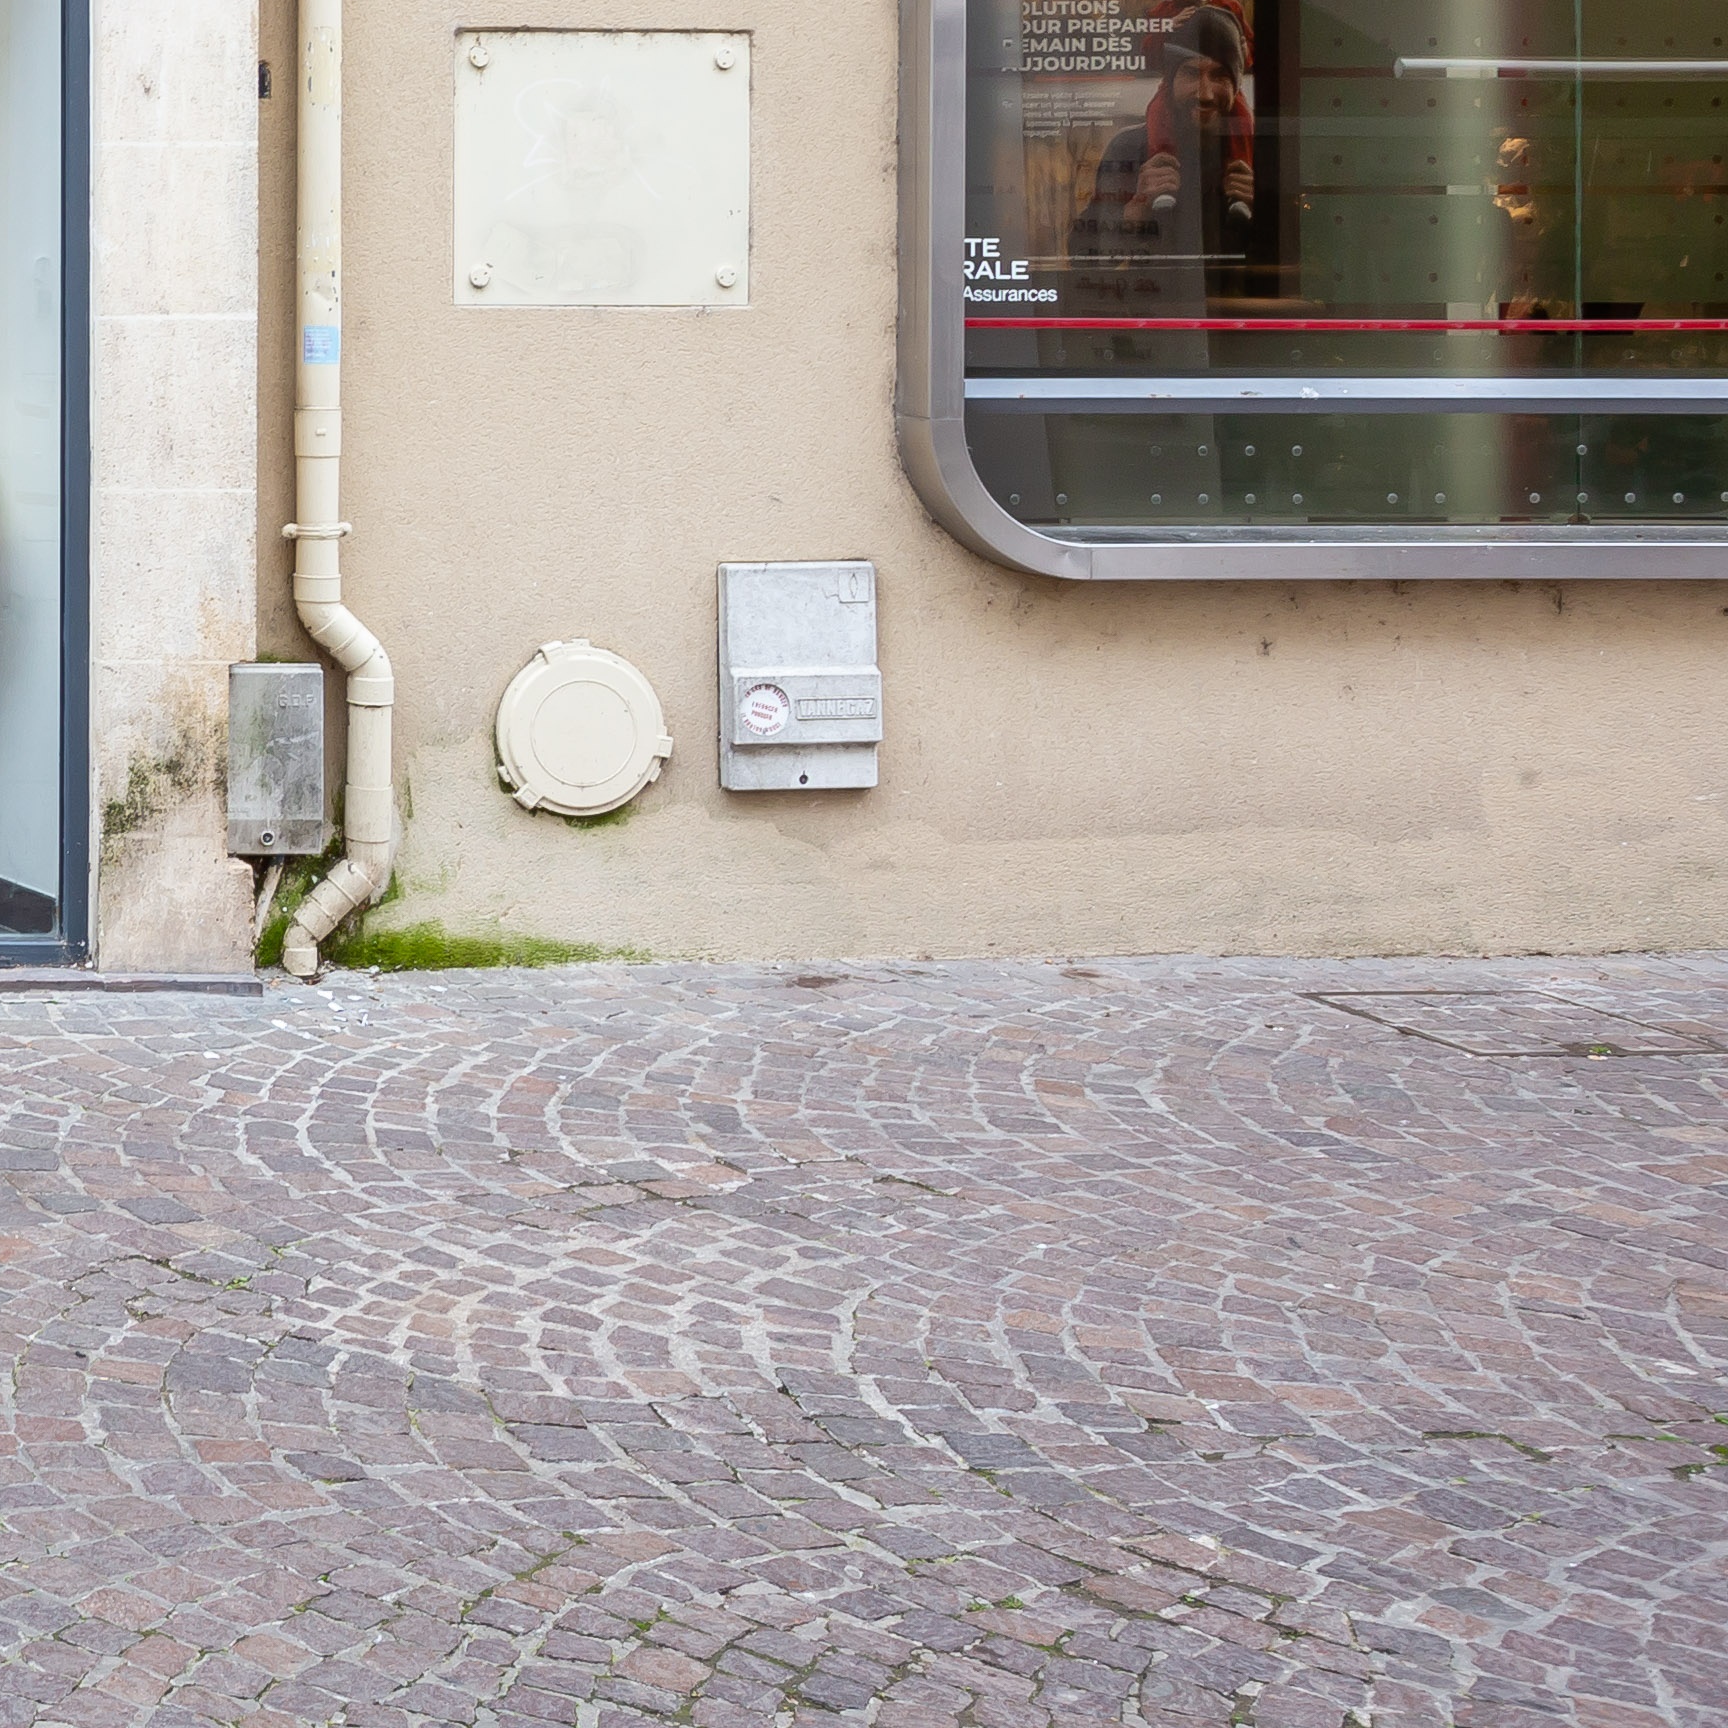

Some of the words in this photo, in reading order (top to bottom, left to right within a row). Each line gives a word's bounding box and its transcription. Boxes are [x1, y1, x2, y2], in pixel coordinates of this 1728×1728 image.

[1022, 0, 1120, 15] OLUTIONS
[1022, 19, 1064, 34] OUR
[1067, 14, 1174, 33] PRÉPARER
[1092, 34, 1132, 52] DÈS
[964, 286, 1058, 301] Assurances
